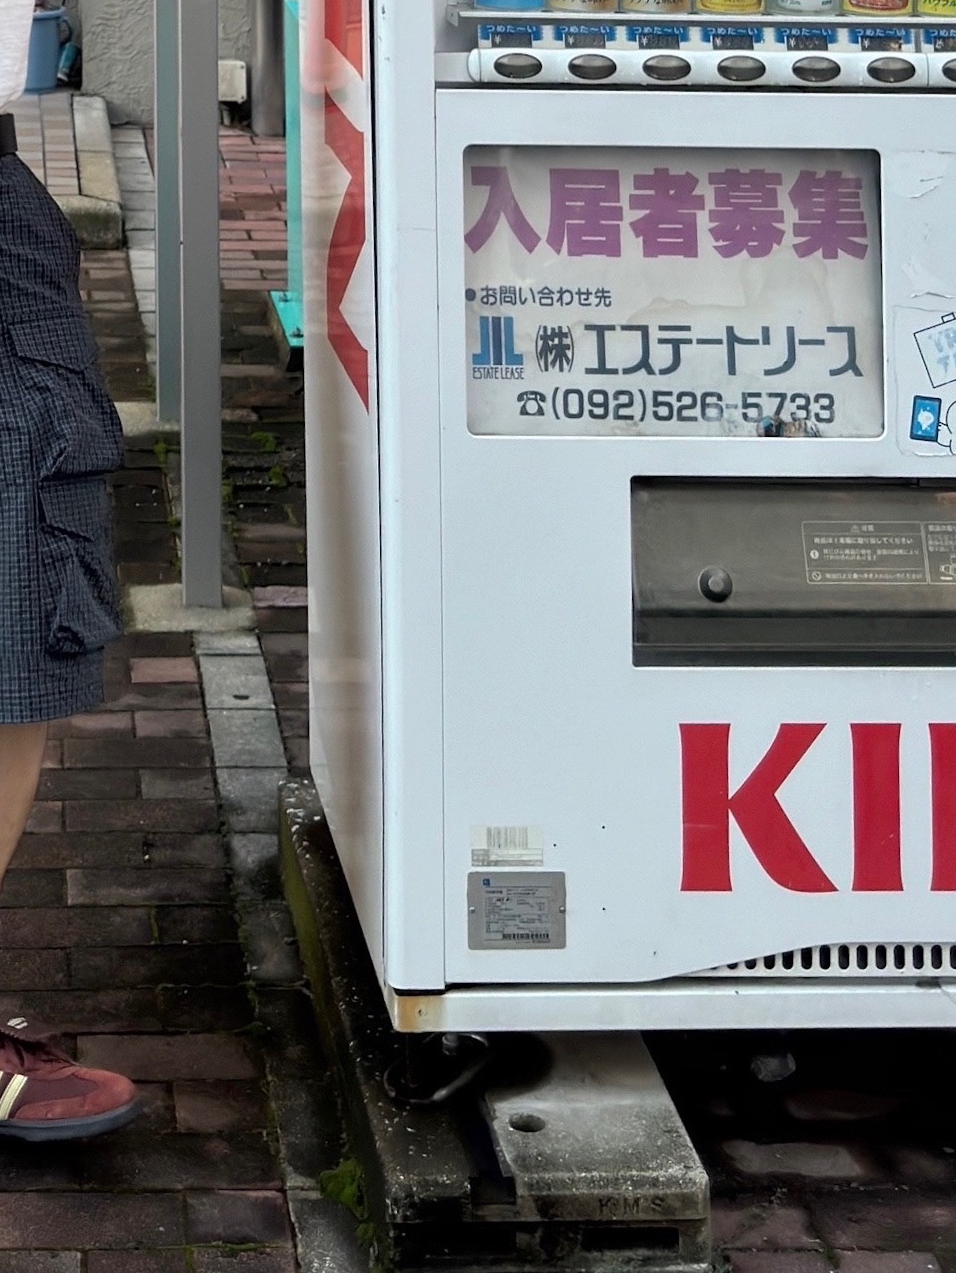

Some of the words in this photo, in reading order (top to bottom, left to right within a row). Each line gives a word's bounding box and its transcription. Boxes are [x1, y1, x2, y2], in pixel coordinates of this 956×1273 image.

[463, 166, 869, 261] 入居者募集
[480, 285, 612, 308] お問い合わせ先
[472, 366, 500, 379] ESTATE
[500, 366, 524, 379] LEASE
[552, 387, 835, 424] (092)526-5733
[679, 722, 956, 894] KI
